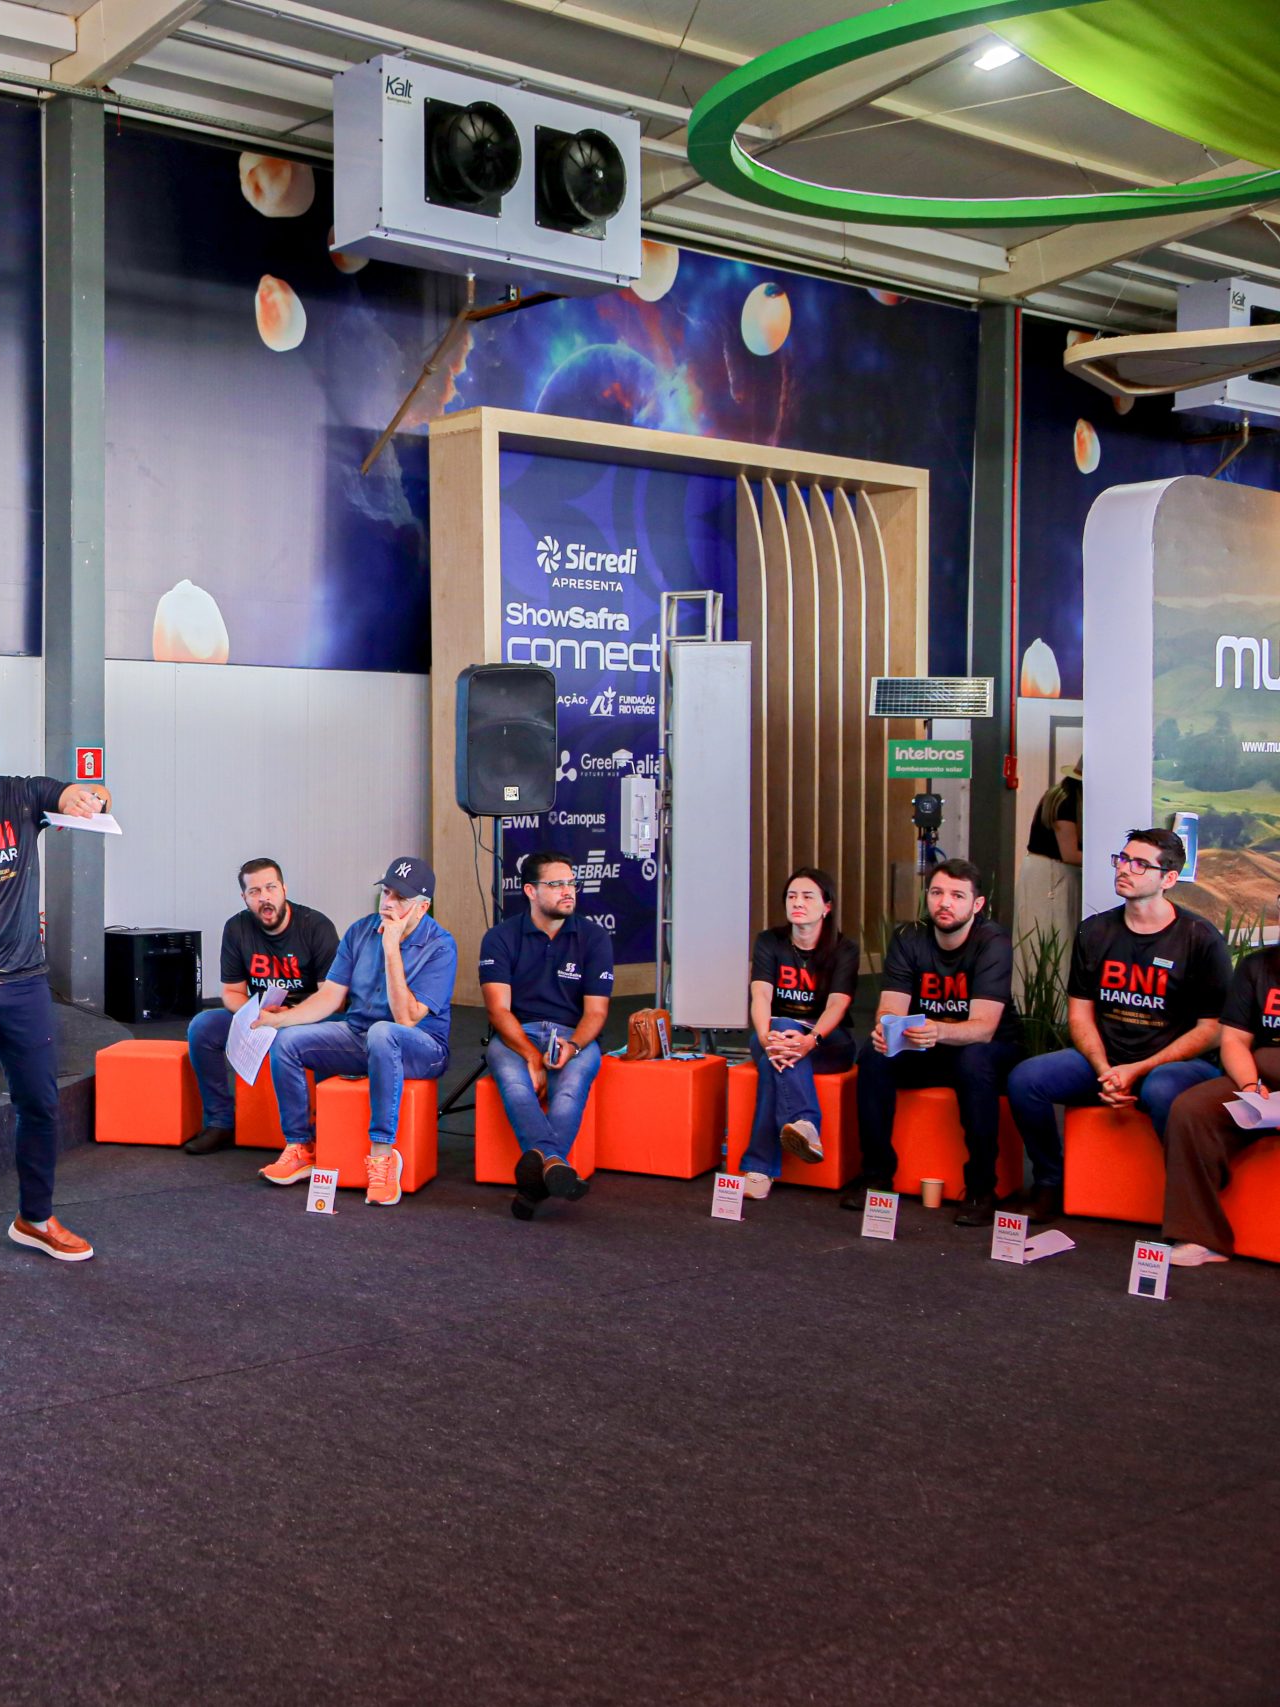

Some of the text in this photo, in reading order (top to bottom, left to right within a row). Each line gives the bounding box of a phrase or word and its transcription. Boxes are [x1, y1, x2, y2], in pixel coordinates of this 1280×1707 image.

[385, 75, 413, 99] Kalt
[565, 543, 638, 575] Sicredi
[552, 577, 624, 592] APRESENTA
[506, 602, 629, 632] ShowSafra
[507, 633, 661, 673] connect
[619, 695, 656, 706] FUNDAÇÃO
[619, 705, 655, 715] RIO VERDE
[558, 811, 606, 828] Canopus
[572, 864, 620, 879] SEBRAE
[251, 977, 304, 989] HANGAR
[776, 987, 815, 1002] HANGA
[1100, 988, 1165, 1010] HANGAR
[919, 998, 969, 1013] HANGAR
